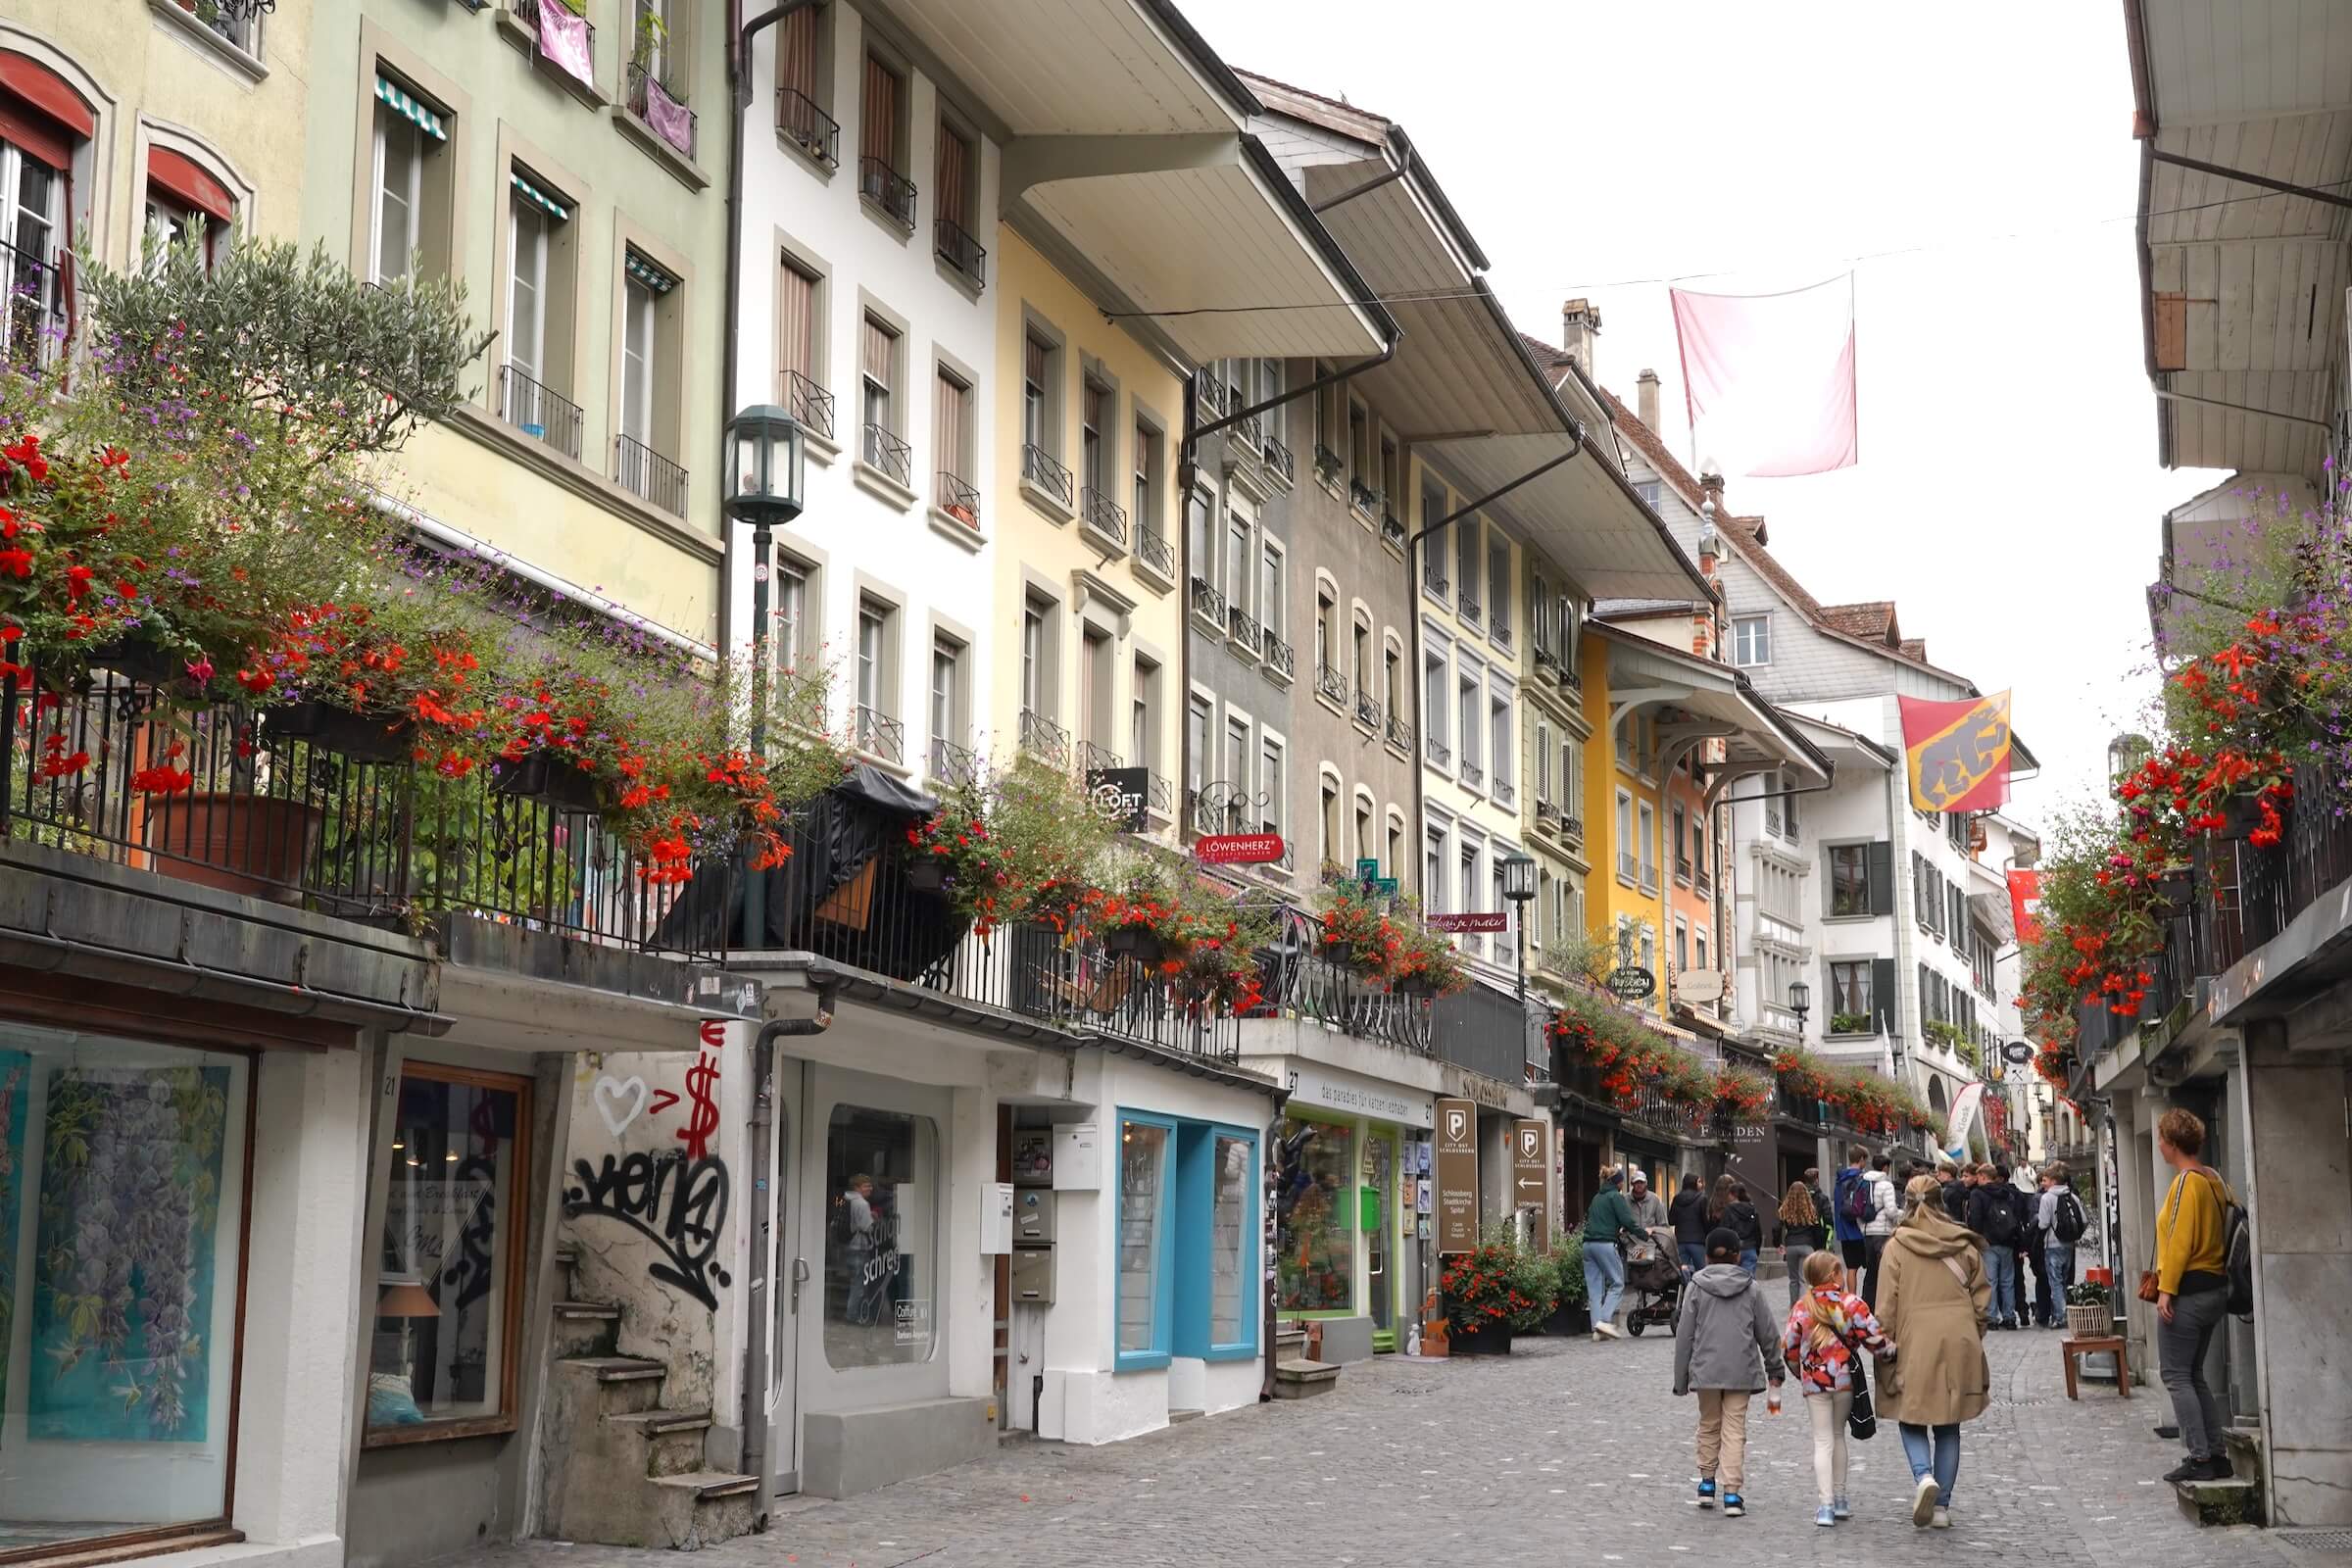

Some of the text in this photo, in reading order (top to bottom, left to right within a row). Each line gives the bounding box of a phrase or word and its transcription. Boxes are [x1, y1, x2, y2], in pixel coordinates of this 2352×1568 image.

[1205, 840, 1271, 853] LÖWENHERZ
[384, 1076, 395, 1097] 21
[1289, 1070, 1299, 1097] 27
[1321, 1082, 1332, 1101] das
[1334, 1088, 1357, 1106] paradies
[1357, 1089, 1367, 1110] für
[1425, 1103, 1433, 1125] 27
[1449, 1113, 1463, 1137] P
[1957, 1104, 1971, 1133] Kiosk
[1524, 1132, 1537, 1153] P
